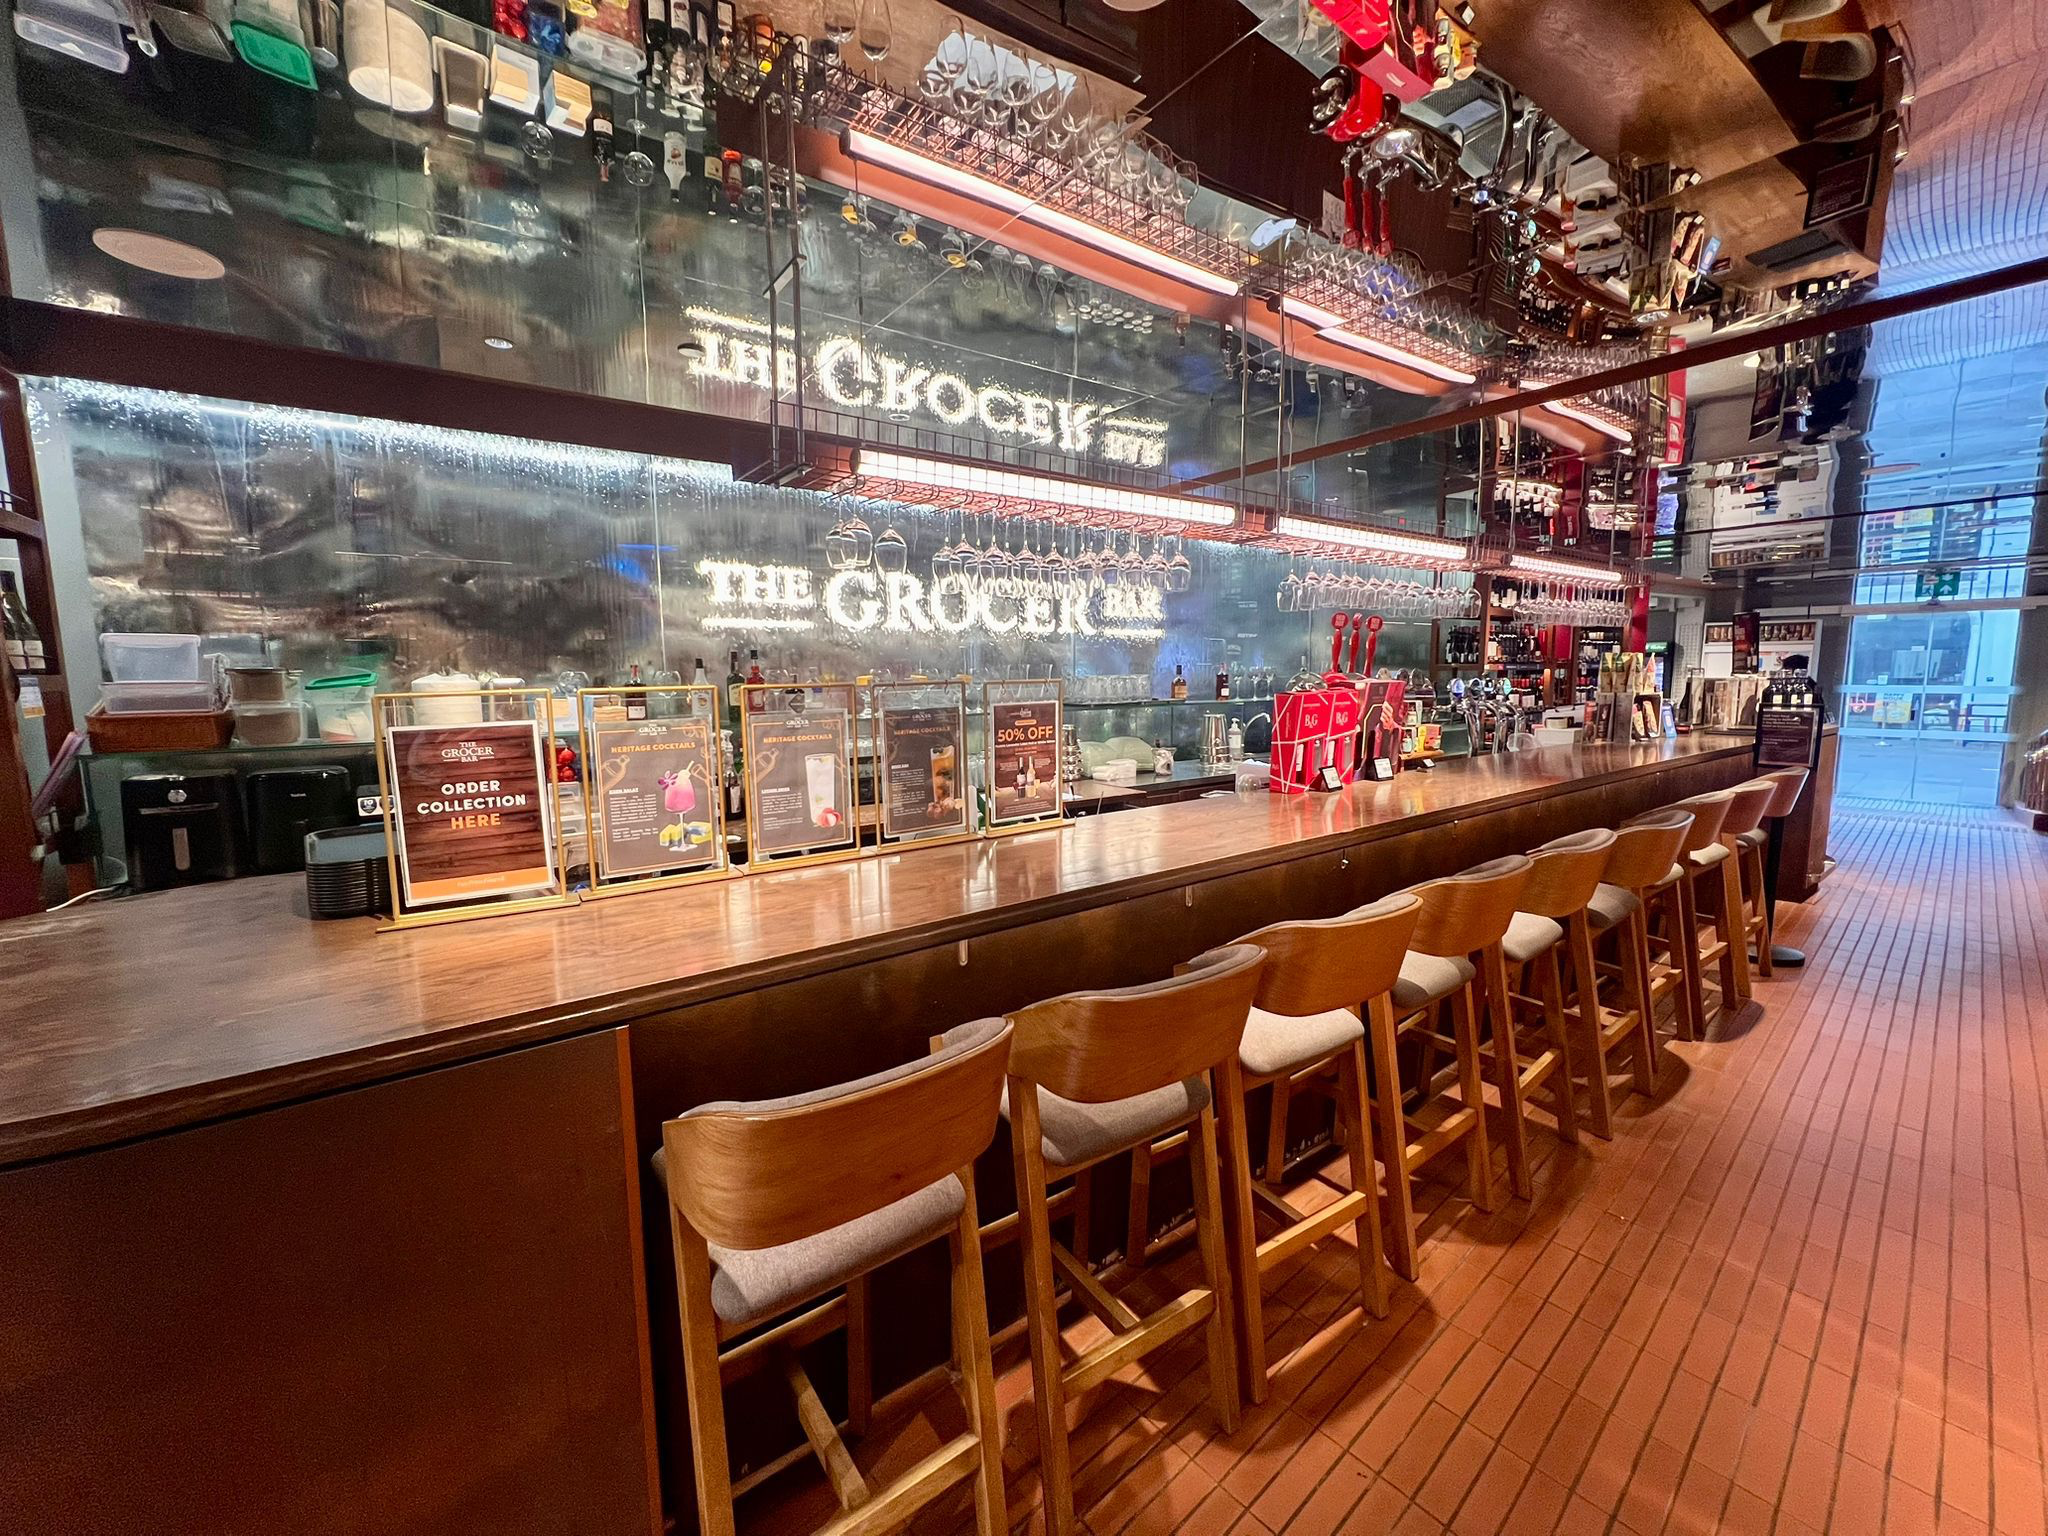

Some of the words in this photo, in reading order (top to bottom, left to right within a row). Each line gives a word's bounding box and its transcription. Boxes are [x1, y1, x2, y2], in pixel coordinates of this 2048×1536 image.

[698, 560, 815, 606] THE
[763, 735, 796, 744] HERITAGE
[797, 733, 833, 742] COCKTAILS
[997, 727, 1025, 742] 50%
[1027, 725, 1054, 740] OFF
[441, 746, 495, 759] GROCER
[611, 744, 651, 753] HERITAGE
[652, 741, 696, 751] COCKTAILS
[461, 755, 479, 763] BAR
[441, 780, 501, 795] ORDER
[416, 794, 527, 815] COLLECTION
[450, 813, 501, 830] HERE
